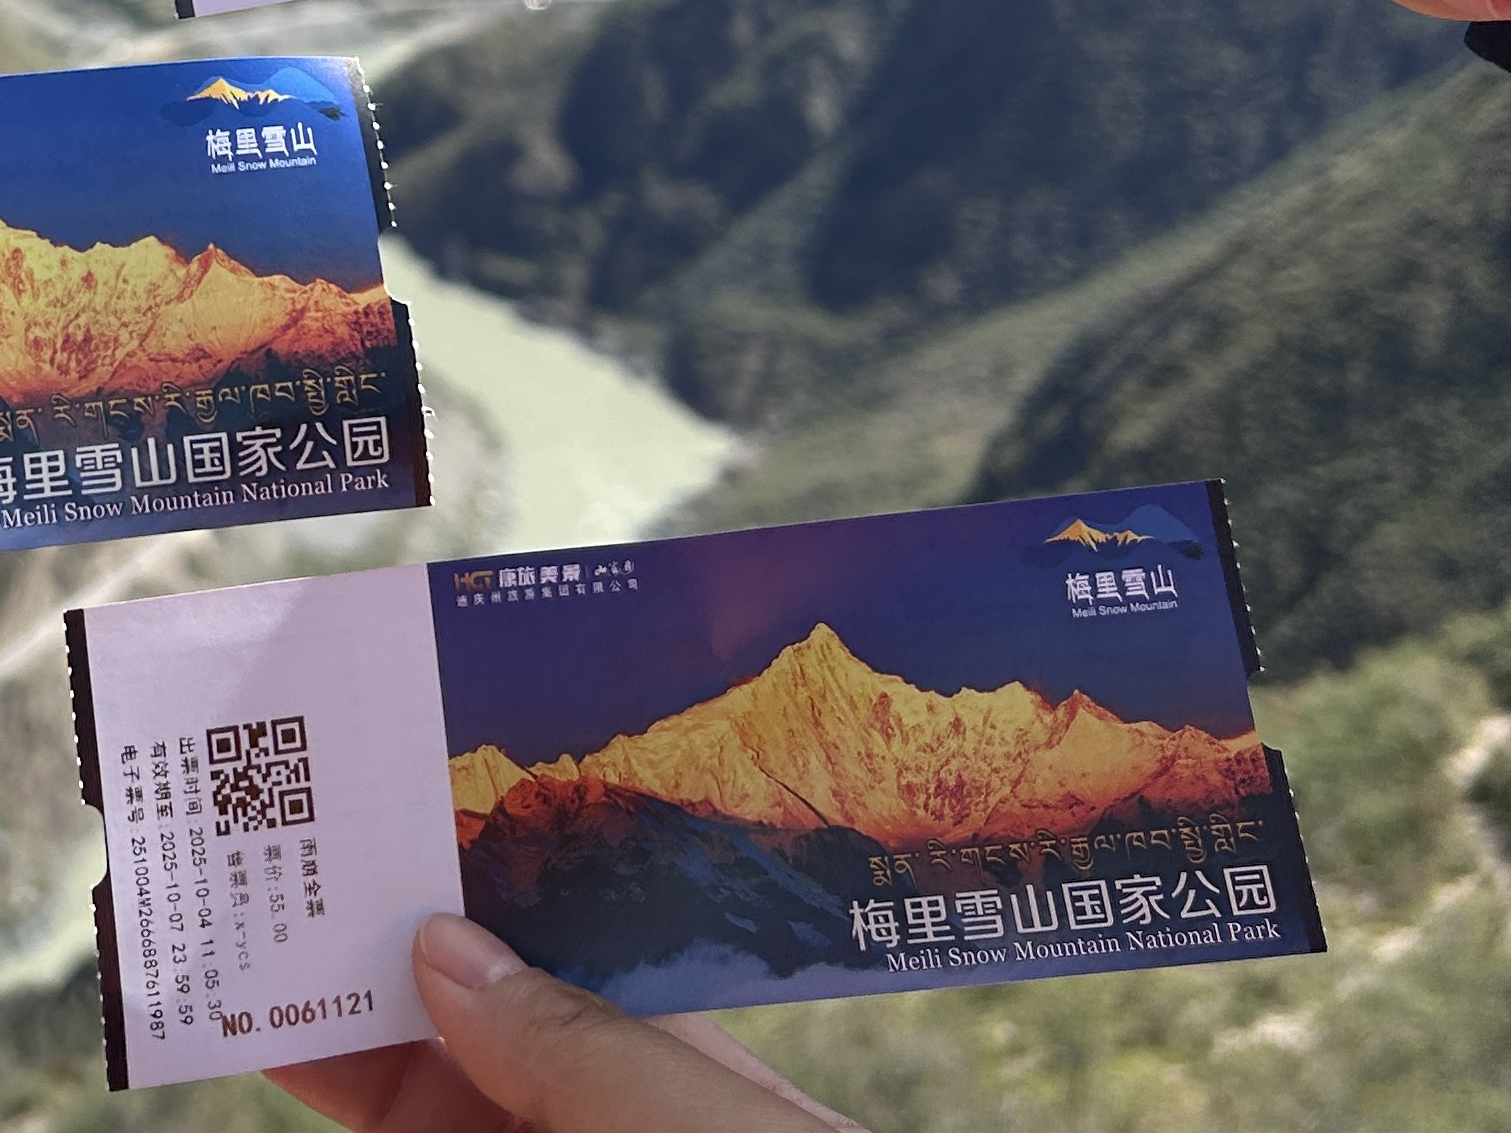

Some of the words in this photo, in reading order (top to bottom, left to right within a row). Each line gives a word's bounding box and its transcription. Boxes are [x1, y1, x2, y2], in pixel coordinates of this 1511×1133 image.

[206, 122, 317, 161] 梅里雪山
[211, 163, 235, 174] Meili
[238, 160, 267, 171] Snow
[269, 156, 316, 169] Mountain
[1, 503, 57, 530] Meili
[65, 498, 123, 522] Snow
[131, 489, 234, 516] Mountain
[241, 478, 333, 504] National
[340, 471, 389, 492] Park
[1065, 564, 1178, 606] 梅里雪山
[1072, 607, 1096, 618] Meili
[1098, 604, 1128, 616] Snow
[1130, 599, 1178, 612] Mountain
[849, 864, 1277, 953] 梅里雪山国家公园
[886, 950, 941, 974] Meili
[949, 944, 1007, 967] Snow
[1013, 935, 1121, 962] Mountain
[1128, 924, 1222, 952] National
[1229, 918, 1281, 943] Park
